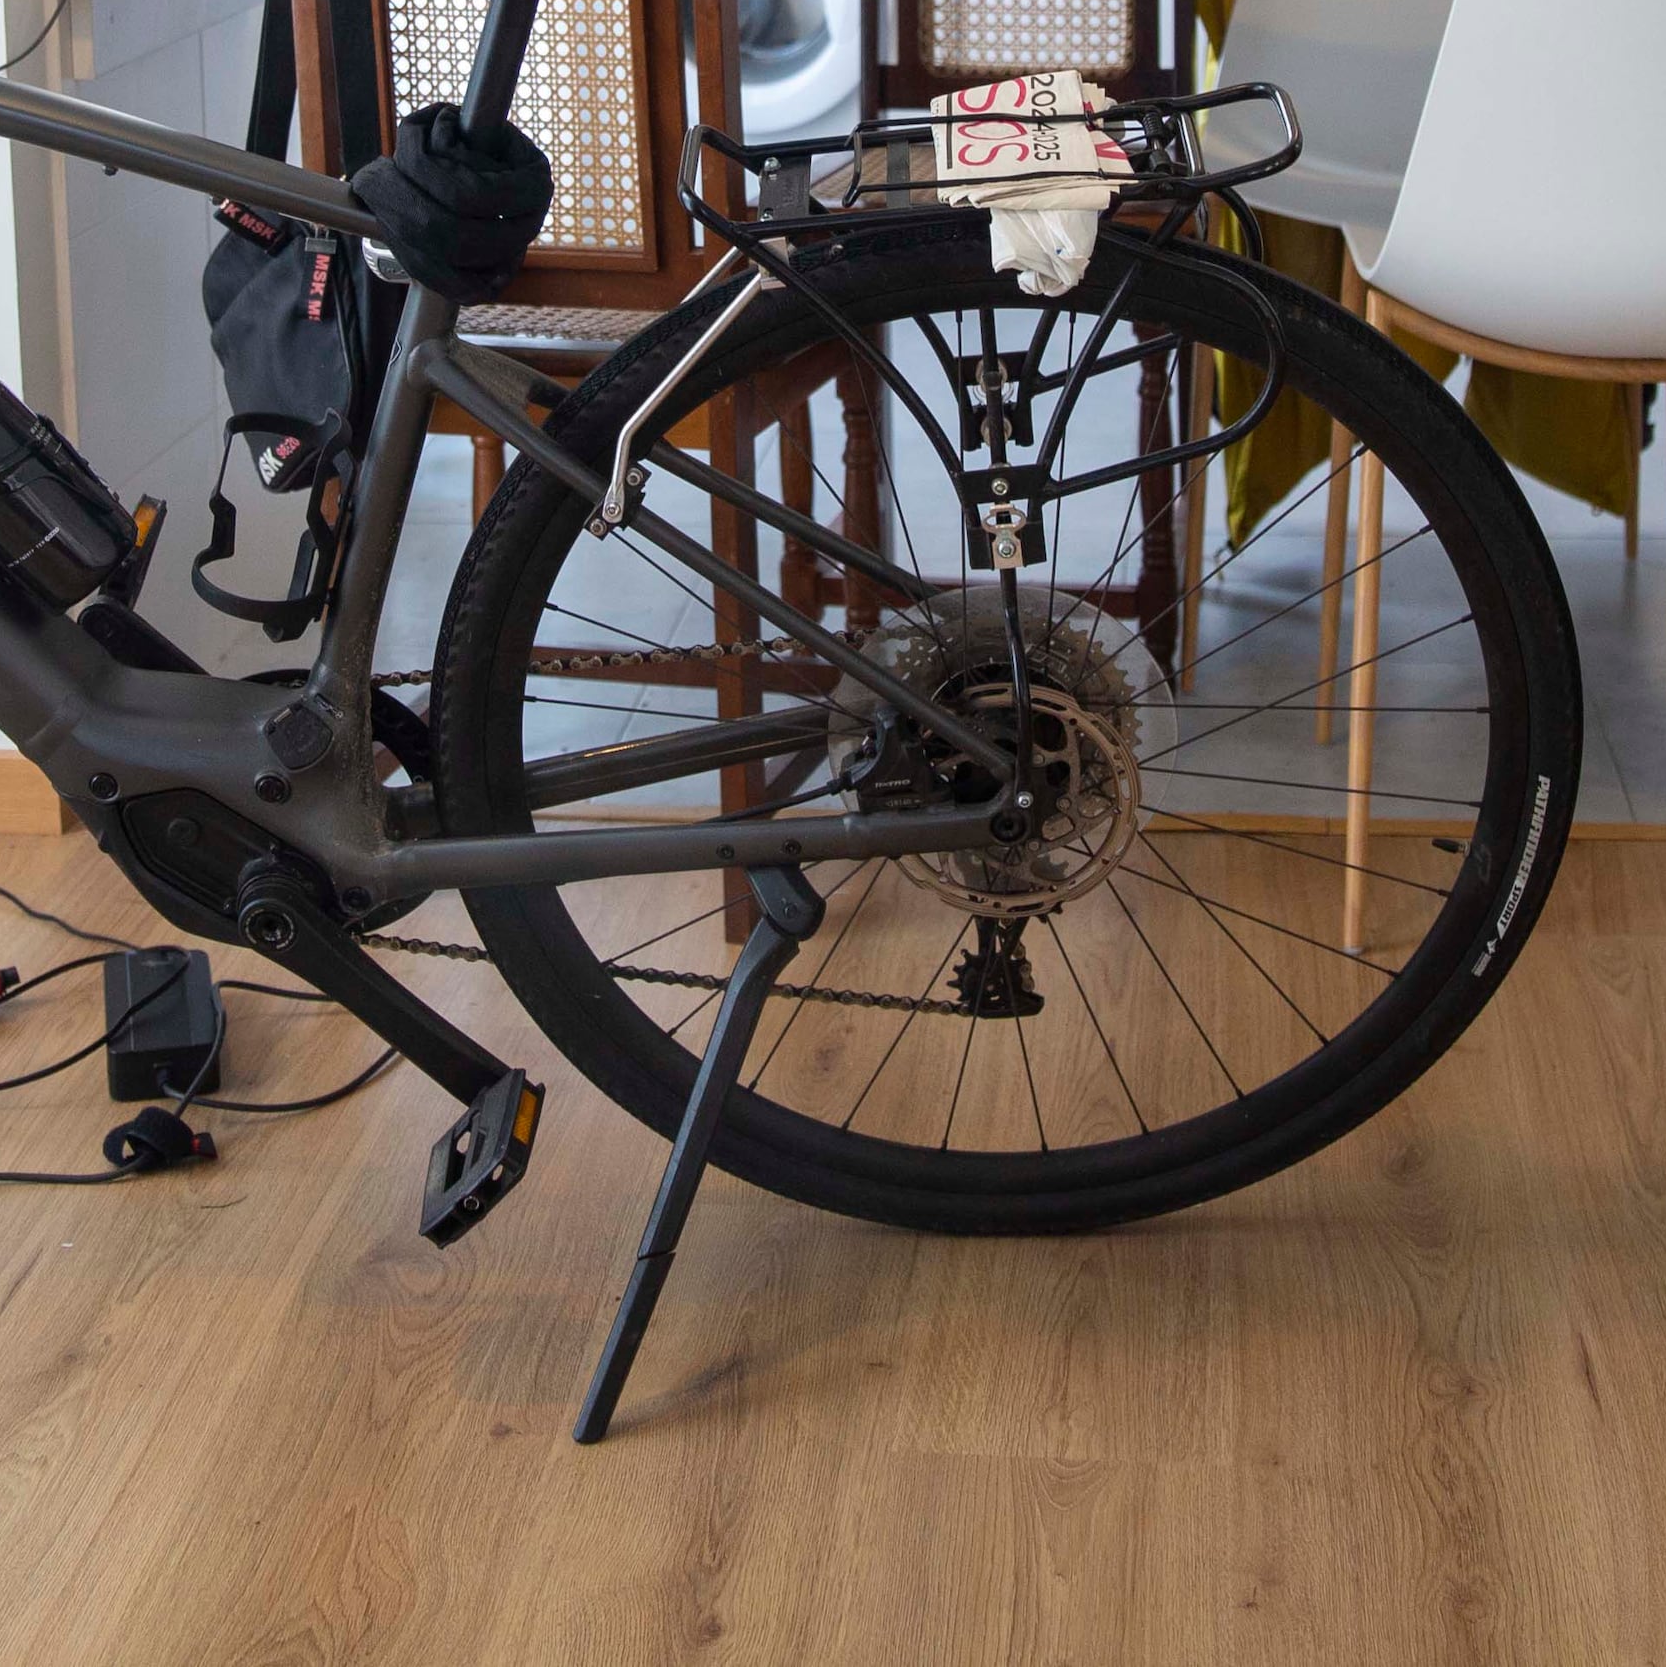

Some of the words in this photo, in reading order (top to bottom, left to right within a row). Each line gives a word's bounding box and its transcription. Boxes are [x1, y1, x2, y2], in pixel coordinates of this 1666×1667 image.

[957, 78, 1030, 166] SOS
[238, 212, 276, 240] MSK
[310, 253, 331, 296] MSK
[1516, 774, 1551, 888] PATHFINDER
[1497, 883, 1524, 931] SPORT
